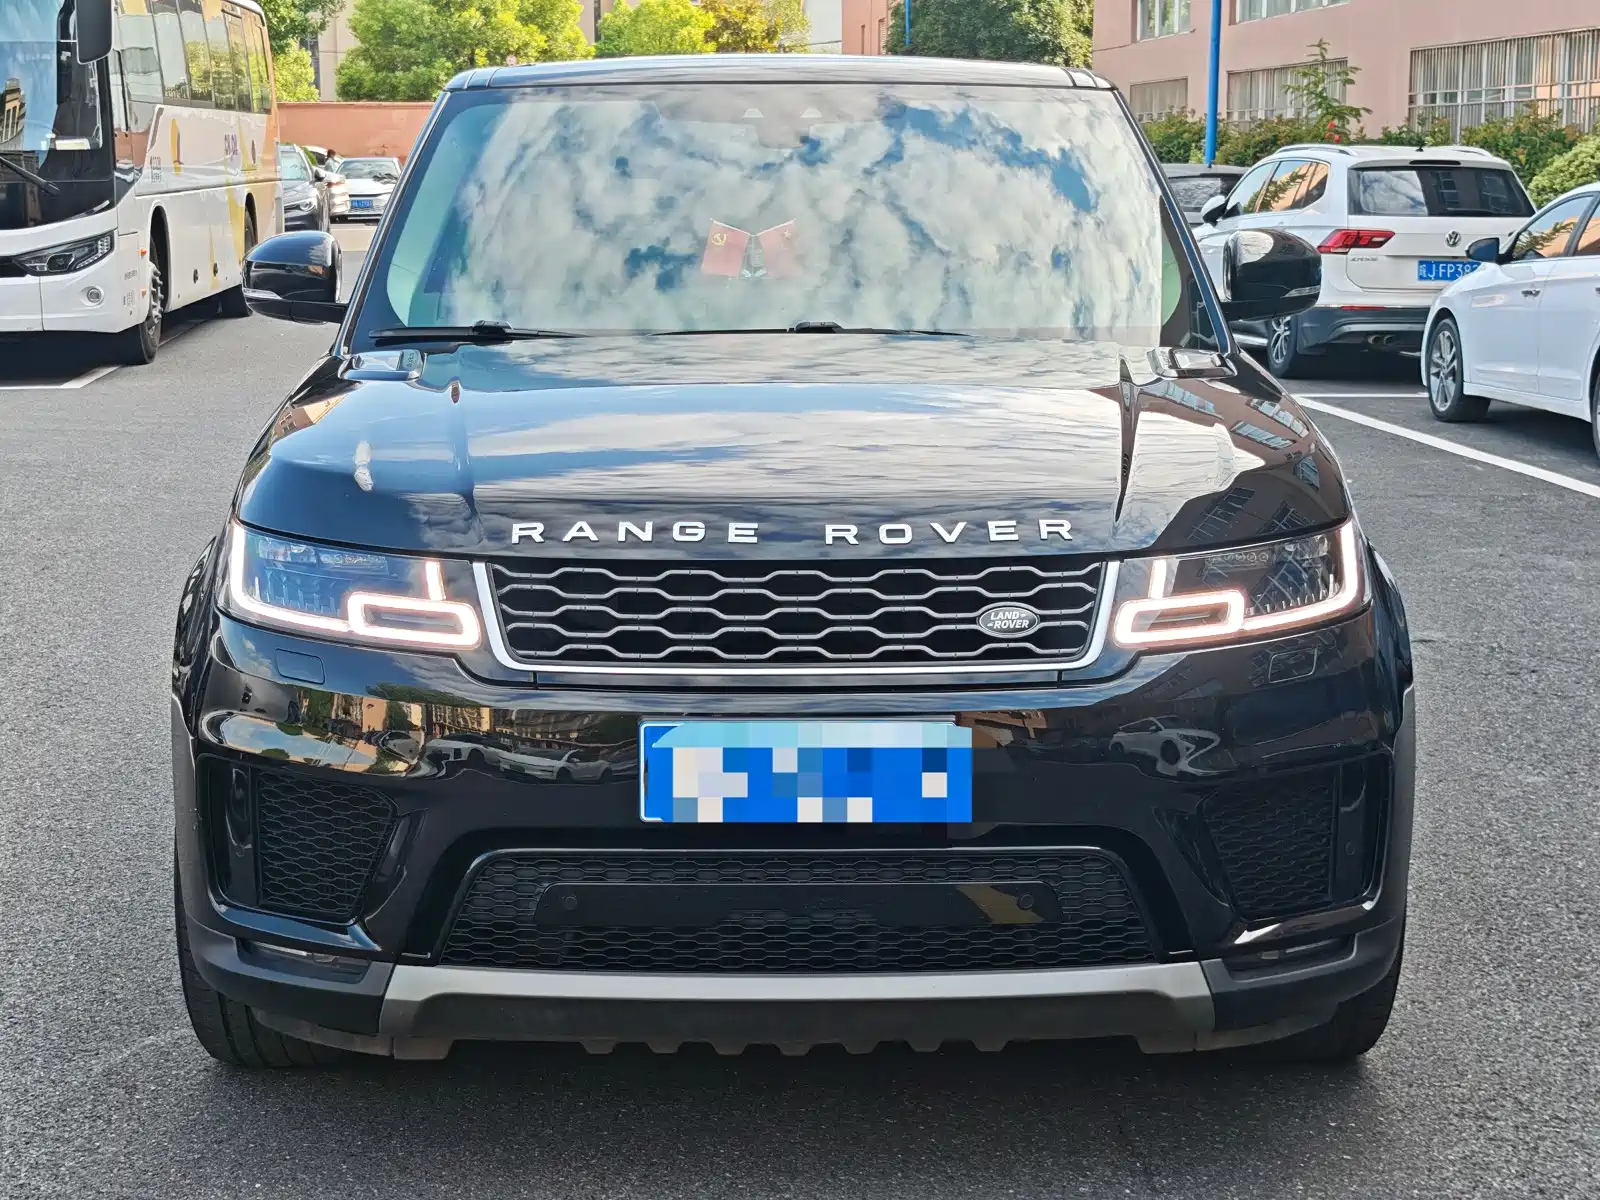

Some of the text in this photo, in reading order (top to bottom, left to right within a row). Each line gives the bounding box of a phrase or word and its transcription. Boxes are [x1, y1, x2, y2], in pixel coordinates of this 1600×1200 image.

[511, 519, 1073, 545] RANGE ROVER
[990, 611, 1020, 620] LAND
[993, 620, 1030, 629] ROVER
